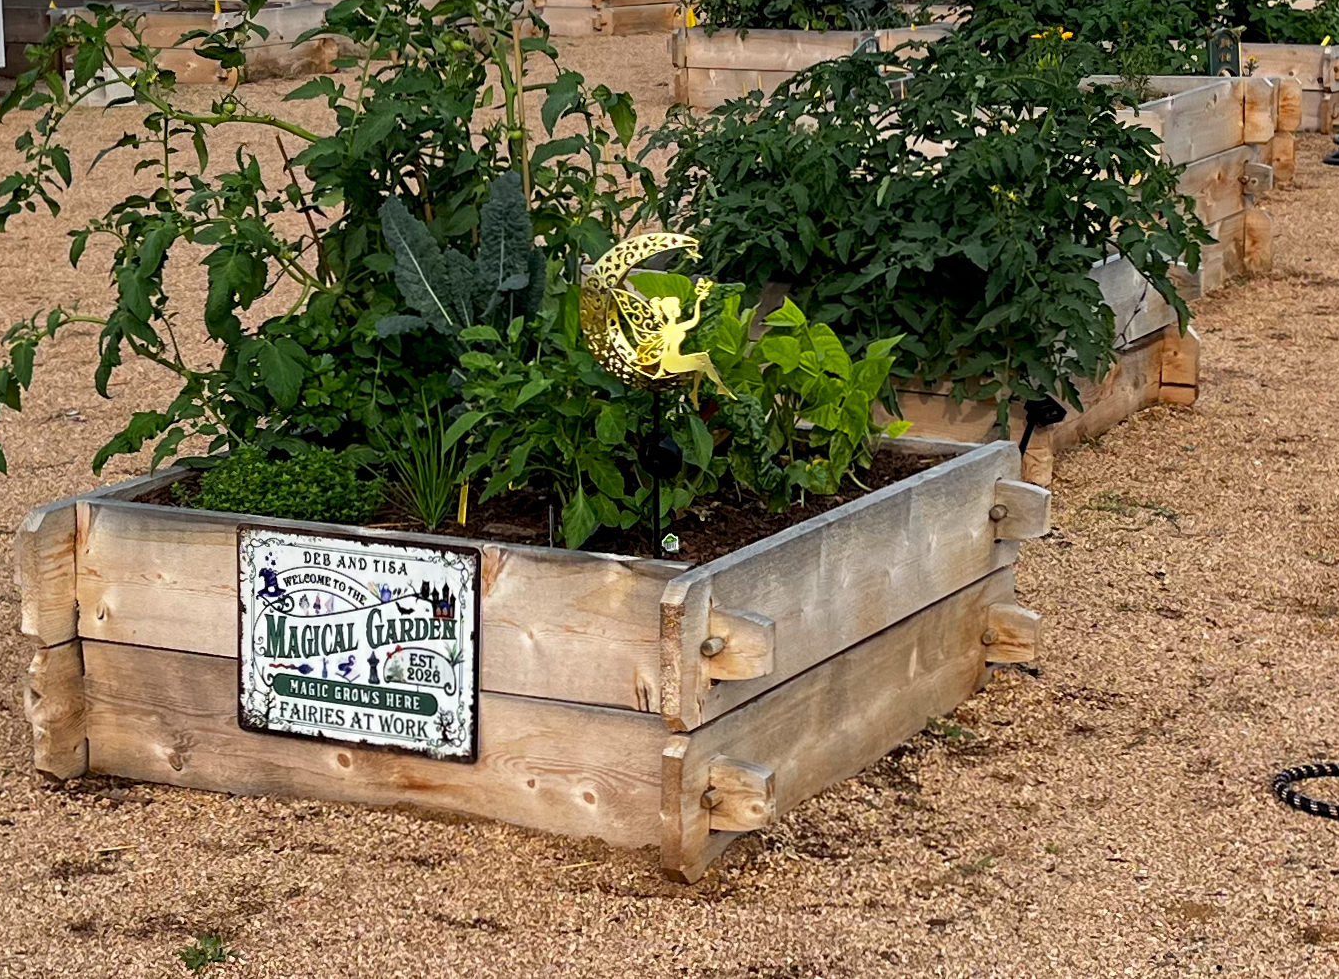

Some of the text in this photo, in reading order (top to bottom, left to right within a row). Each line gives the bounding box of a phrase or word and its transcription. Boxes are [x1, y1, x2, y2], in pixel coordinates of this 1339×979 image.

[303, 551, 408, 576] DEB AND TISA
[282, 573, 368, 606] WELCOME TO THE
[264, 608, 458, 660] MAGICAL GARDEN
[407, 668, 441, 684] 2026
[409, 653, 439, 670] EST.
[289, 679, 421, 710] MAGIC GROWS HERE
[279, 701, 429, 739] FAIRIES AT WORK
